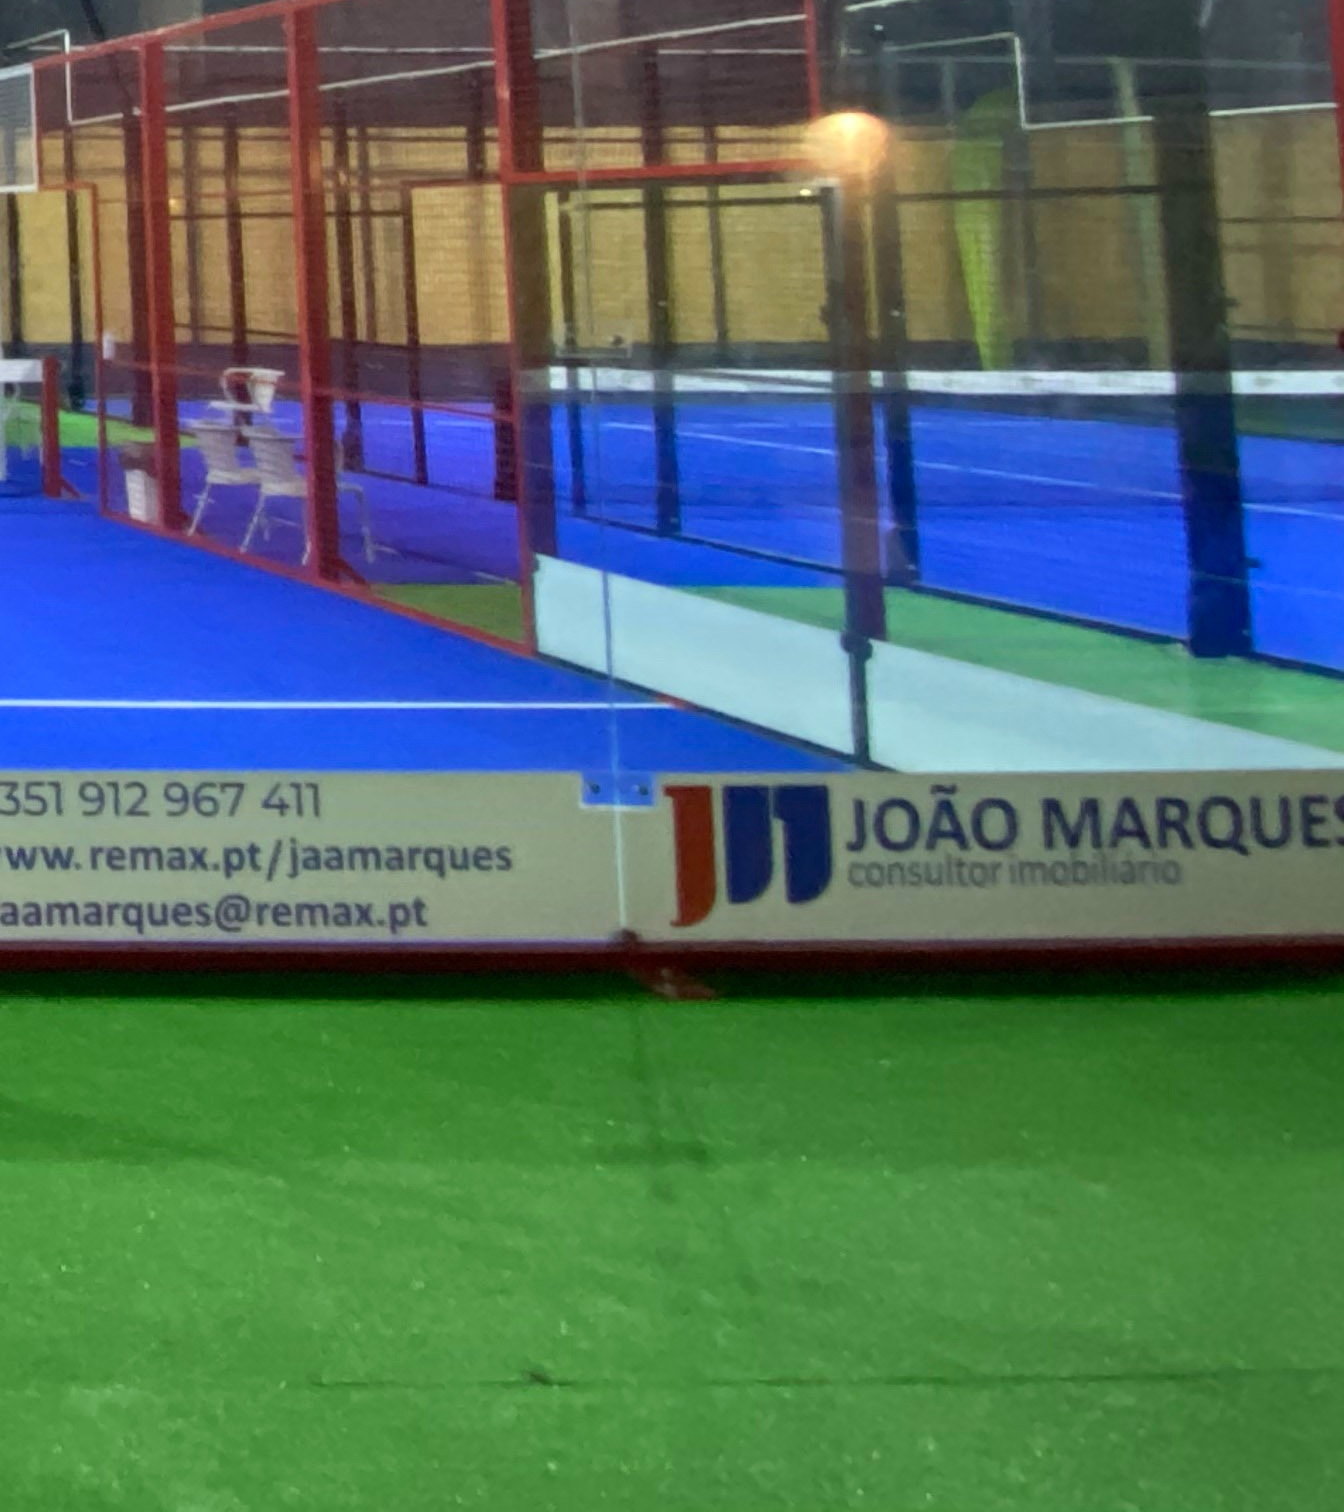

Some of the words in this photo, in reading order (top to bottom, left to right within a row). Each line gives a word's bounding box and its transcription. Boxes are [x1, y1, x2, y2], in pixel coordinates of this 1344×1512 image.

[78, 780, 150, 818] 912
[163, 781, 247, 818] 967
[260, 781, 321, 818] 411
[845, 783, 1020, 853] JOÃO
[846, 855, 1004, 889] consultor
[1009, 851, 1182, 887] imobiliário
